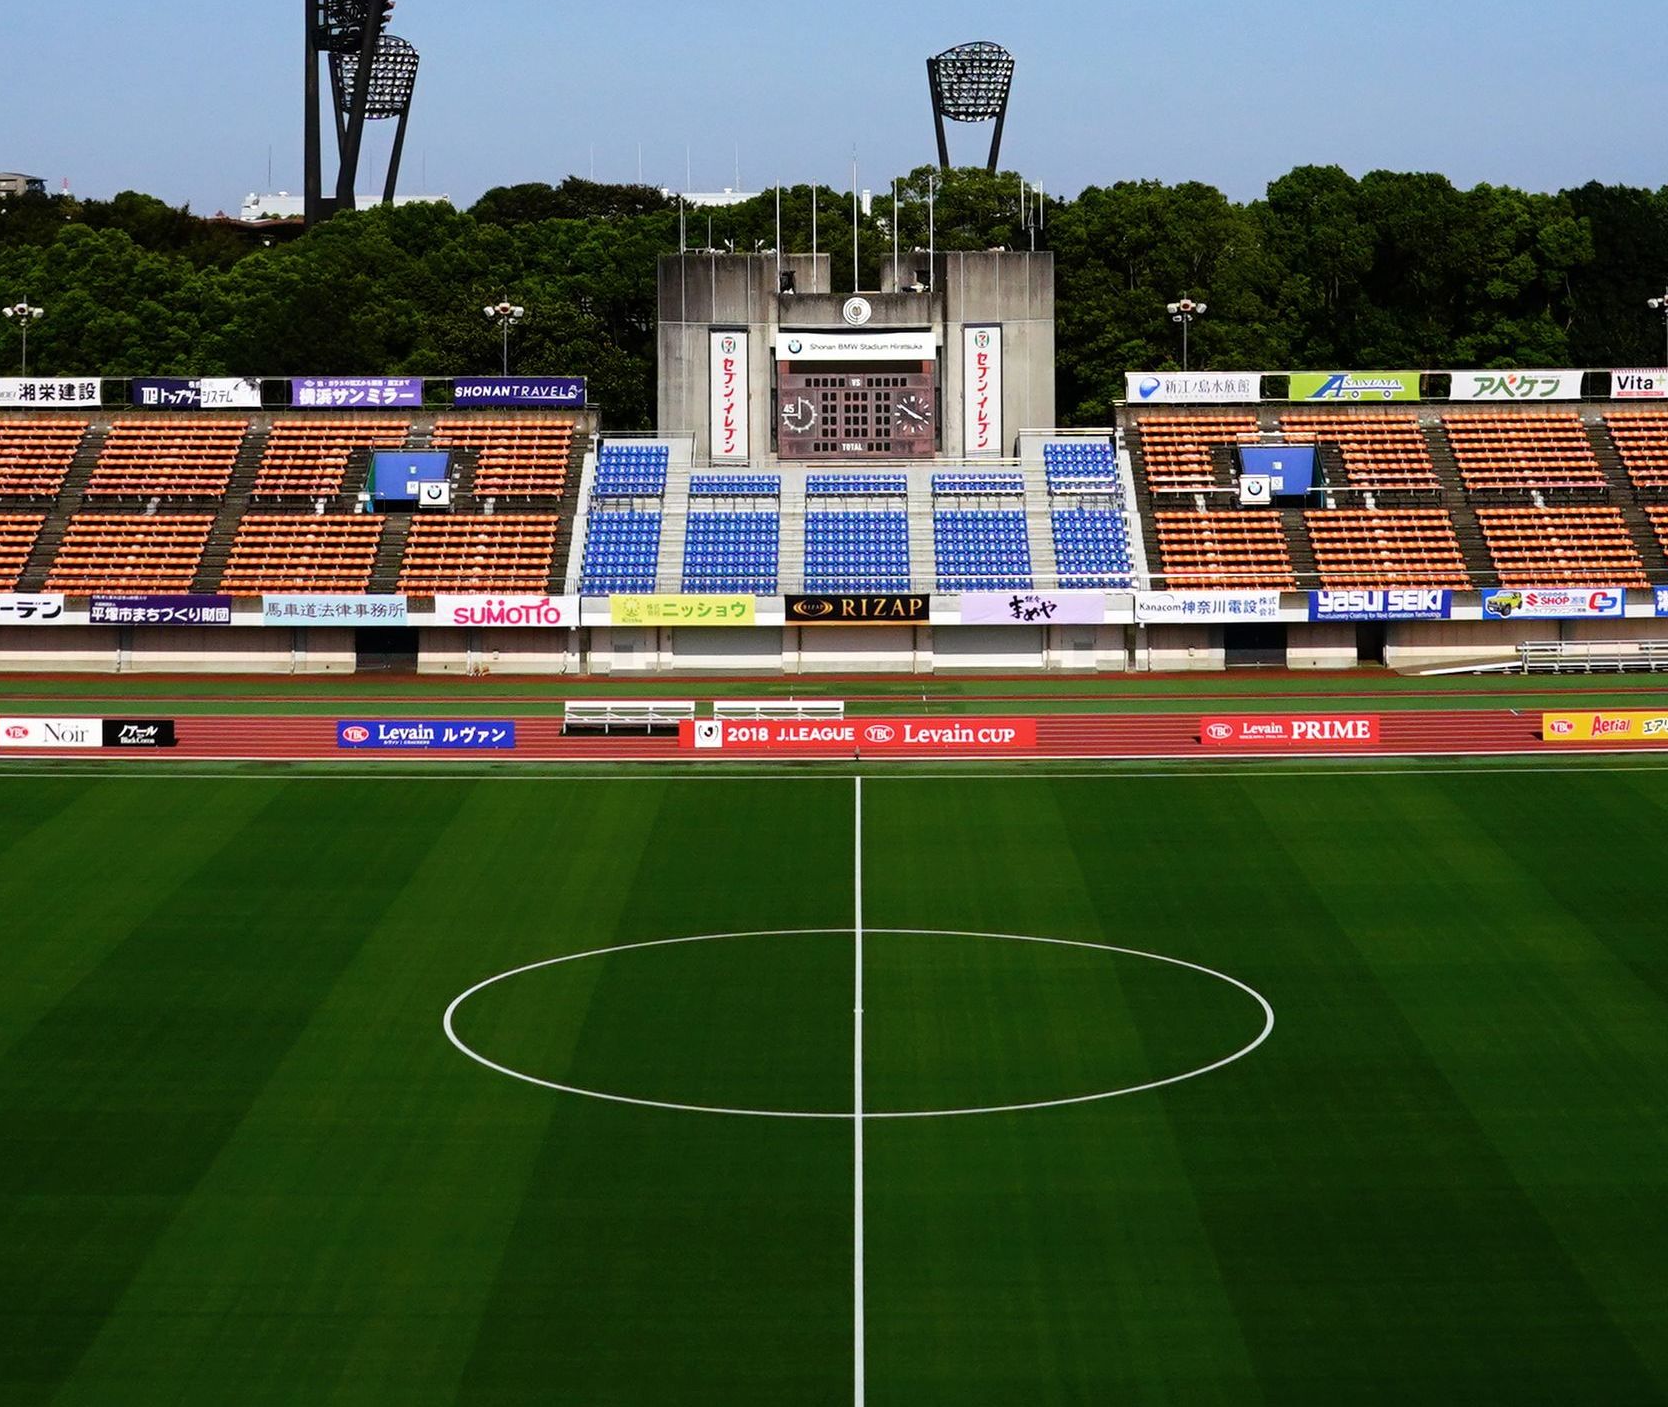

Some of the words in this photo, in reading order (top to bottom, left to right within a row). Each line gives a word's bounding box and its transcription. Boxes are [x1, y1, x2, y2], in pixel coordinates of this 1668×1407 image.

[18, 383, 97, 401] 湘栄建設
[454, 385, 510, 397] SHONAN
[512, 386, 566, 397] TRAVEL
[1165, 379, 1251, 394] 新江ノ島水族館
[299, 388, 414, 405] 横浜サンミラー
[841, 443, 863, 451] TOTAL
[662, 602, 747, 617] ニッショウ
[841, 598, 923, 617] RIZAP
[1139, 602, 1181, 612] Kanacom
[1182, 599, 1257, 615] 神奈川電設
[1540, 596, 1569, 606] SHOP
[92, 606, 230, 622] 平塚市まちづくり財団
[265, 602, 405, 619] 馬車道法律事務所
[44, 723, 85, 742] Noir
[378, 724, 434, 740] Levain
[442, 727, 506, 743] ルヴァン
[727, 728, 769, 741] 2018
[776, 727, 854, 741] J.LEAGUE
[903, 723, 974, 743] Levain
[977, 728, 1015, 743] CUP
[1242, 722, 1283, 734] Levain
[1291, 720, 1370, 739] PRIME
[1591, 715, 1631, 736] Aerial
